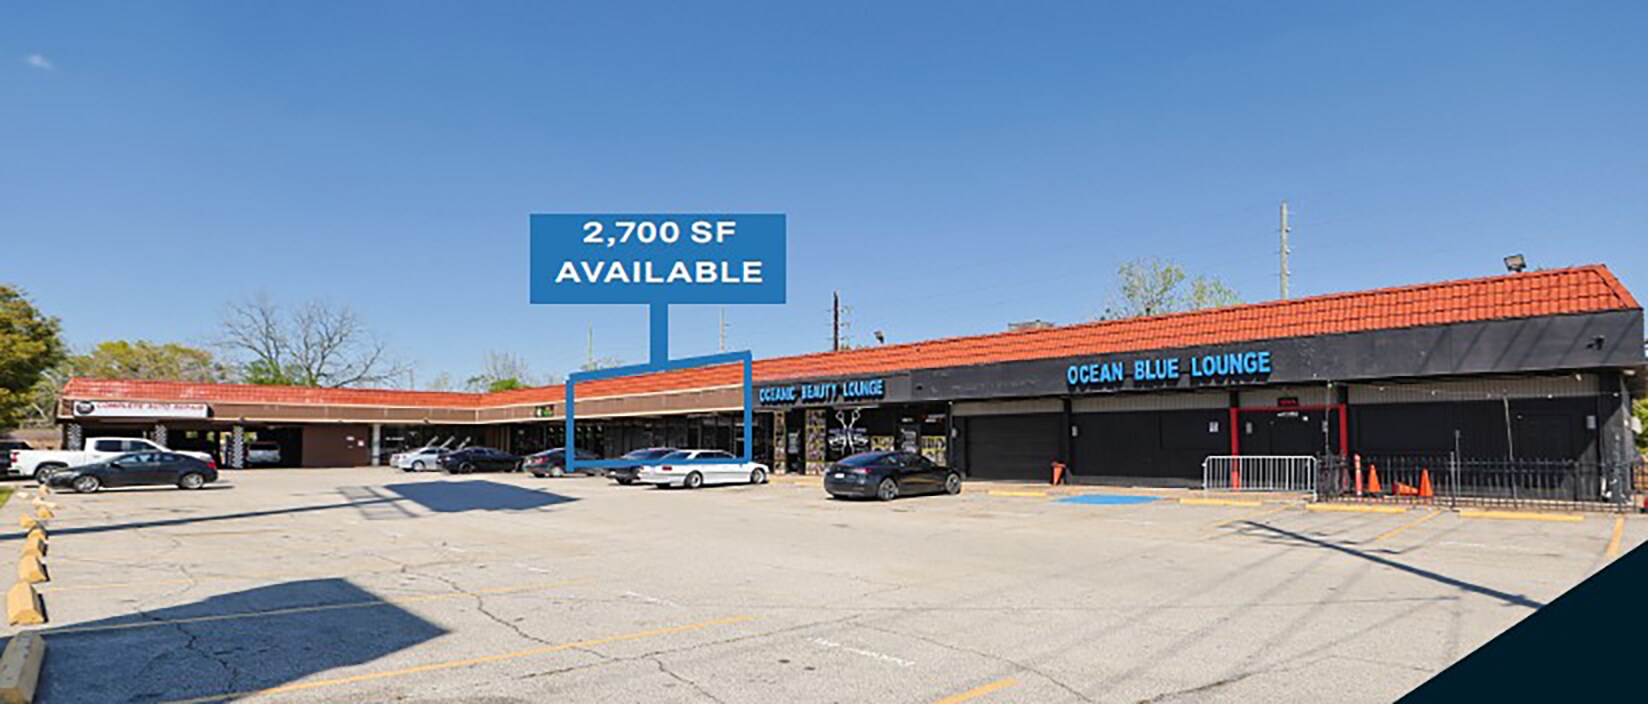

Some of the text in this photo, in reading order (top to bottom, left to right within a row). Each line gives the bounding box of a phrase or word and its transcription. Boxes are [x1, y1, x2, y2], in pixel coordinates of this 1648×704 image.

[1067, 351, 1271, 385] OCEAN BLUE LOUNGE
[843, 379, 884, 397] LOUNGE
